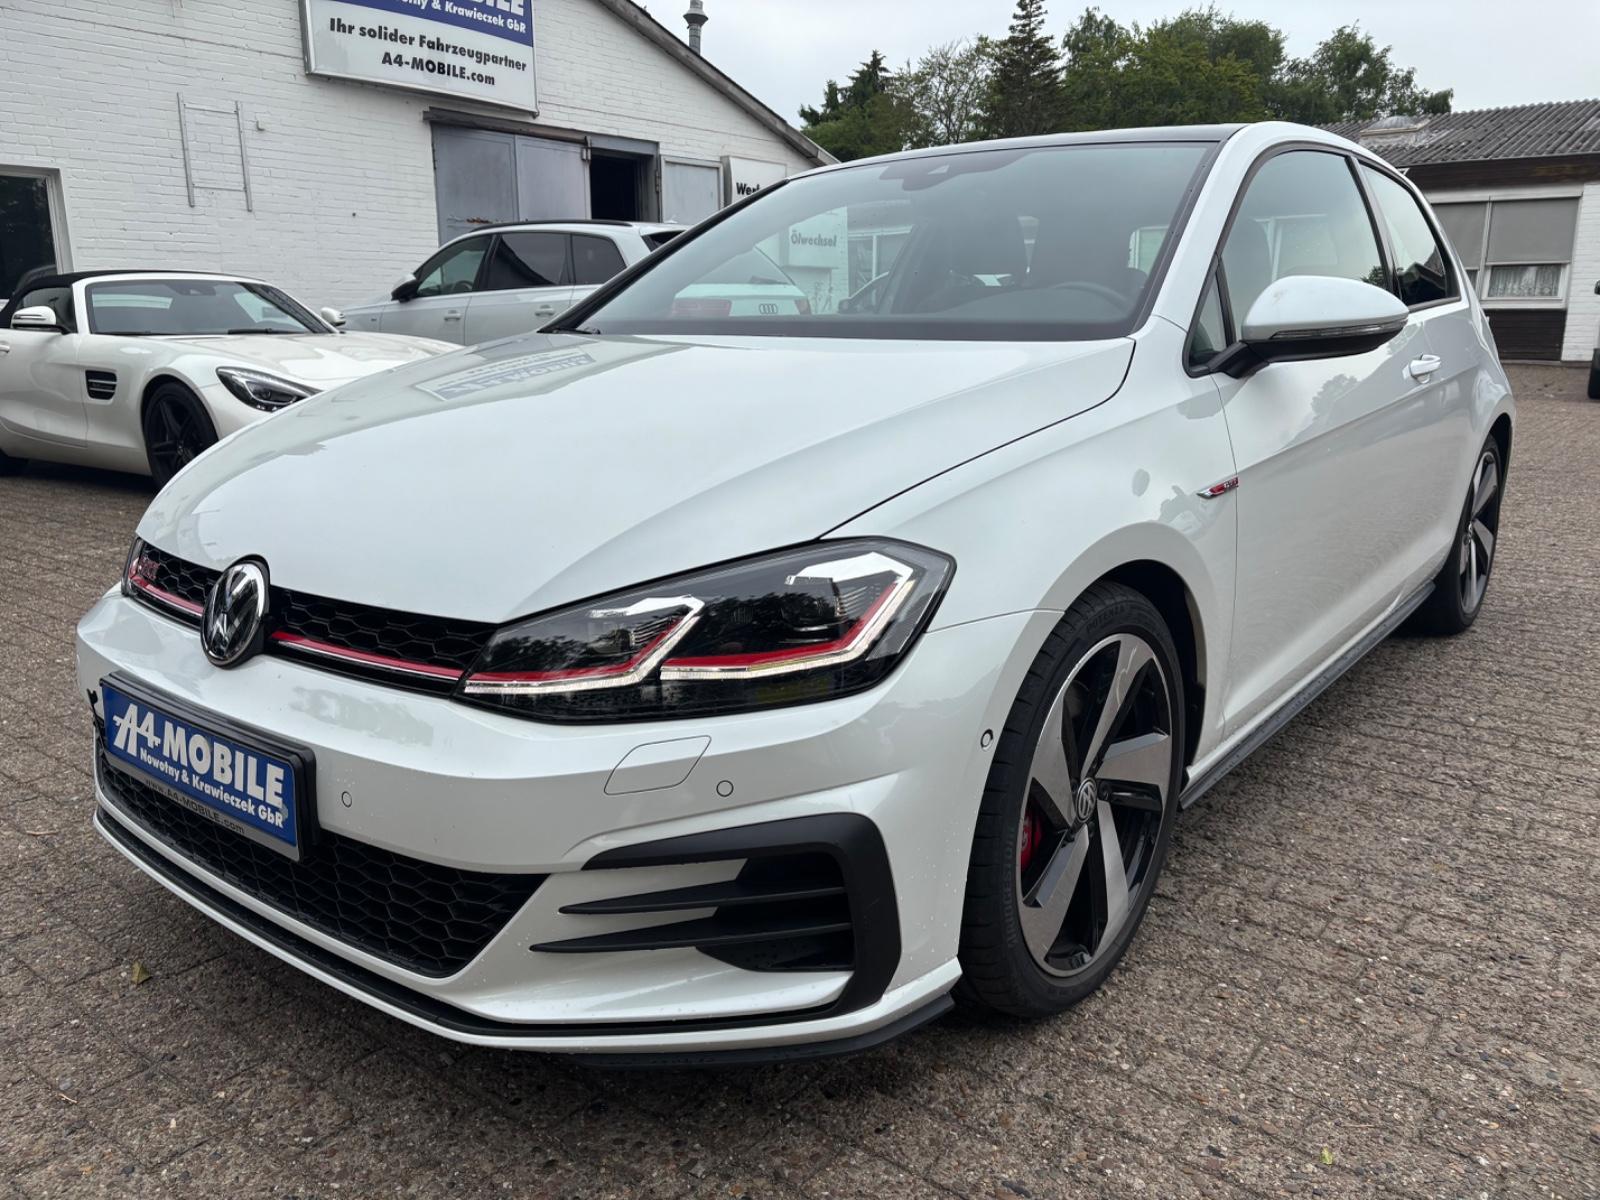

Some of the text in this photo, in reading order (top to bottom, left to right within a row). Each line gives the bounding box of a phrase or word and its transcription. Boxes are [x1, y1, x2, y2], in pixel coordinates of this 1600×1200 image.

[445, 1, 505, 27] Krawieczek
[506, 18, 527, 33] GbR
[329, 18, 528, 72] Ihr solider Fahrzeugpartner
[381, 51, 496, 86] A4-MOBILE.com
[790, 229, 838, 248] Ölwechsel
[162, 720, 285, 809] MOBILE
[140, 748, 285, 829] Nowotny & Krawieczek GbR
